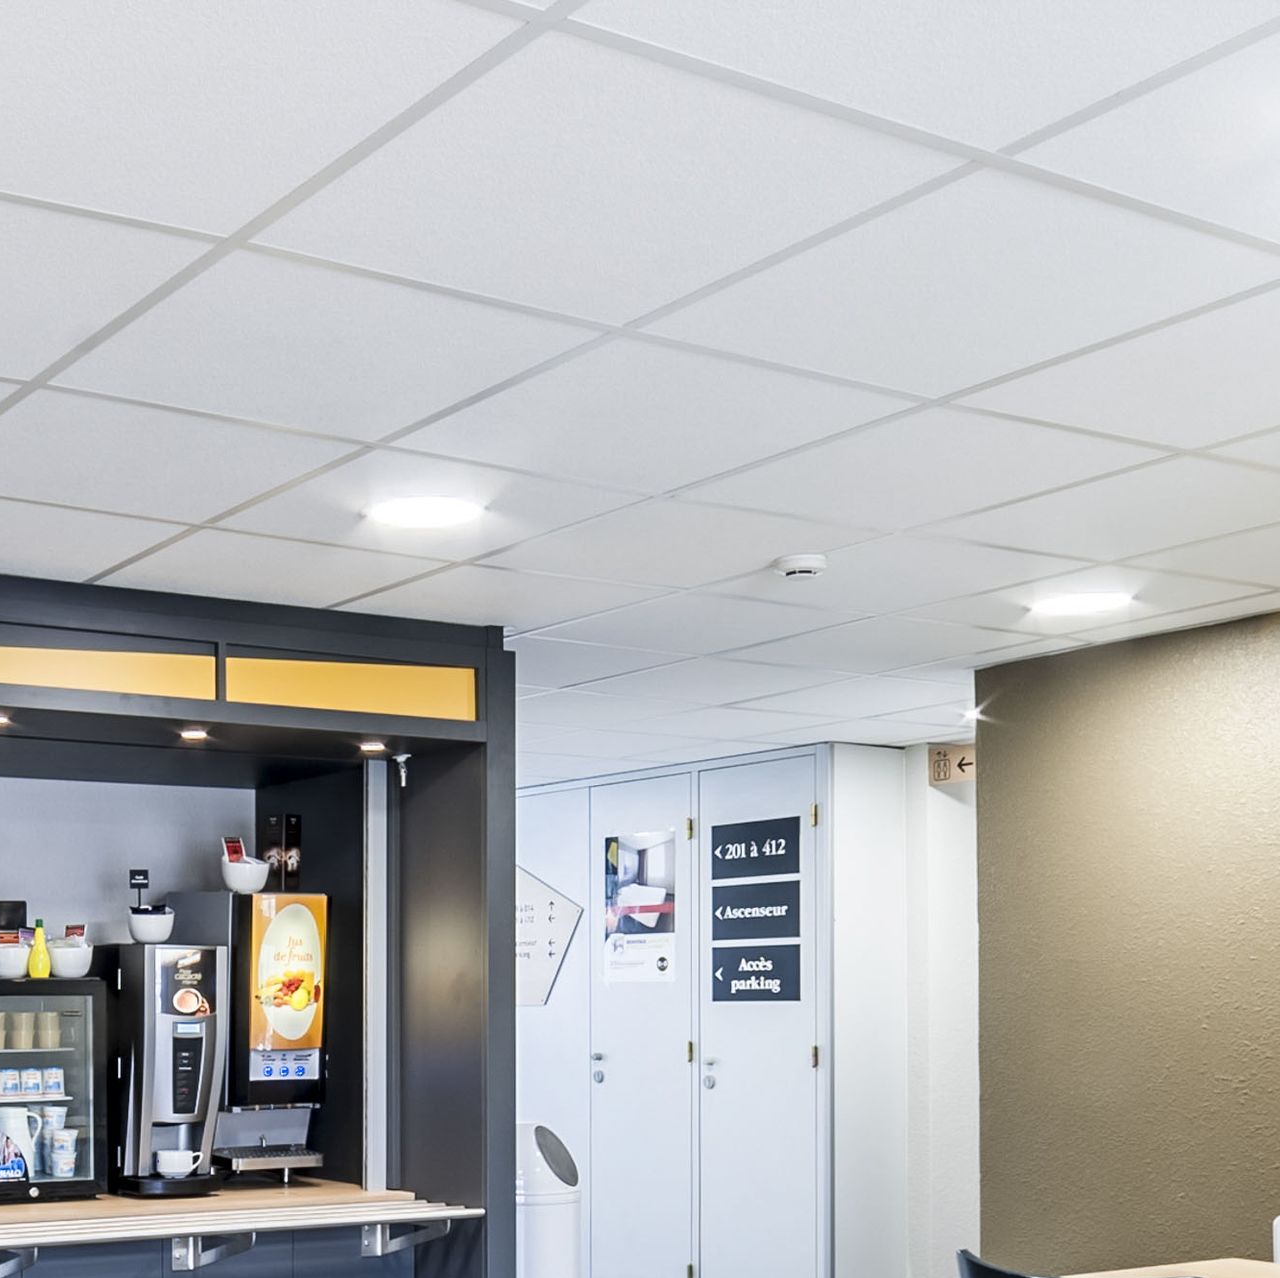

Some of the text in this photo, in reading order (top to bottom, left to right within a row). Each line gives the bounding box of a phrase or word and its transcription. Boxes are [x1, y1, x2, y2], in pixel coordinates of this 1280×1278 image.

[724, 838, 786, 860] 201 à 412
[723, 904, 788, 919] Ascenseur
[287, 935, 304, 948] Jus
[273, 947, 314, 966] de fruits
[738, 956, 773, 971] Accès
[730, 974, 782, 994] parking
